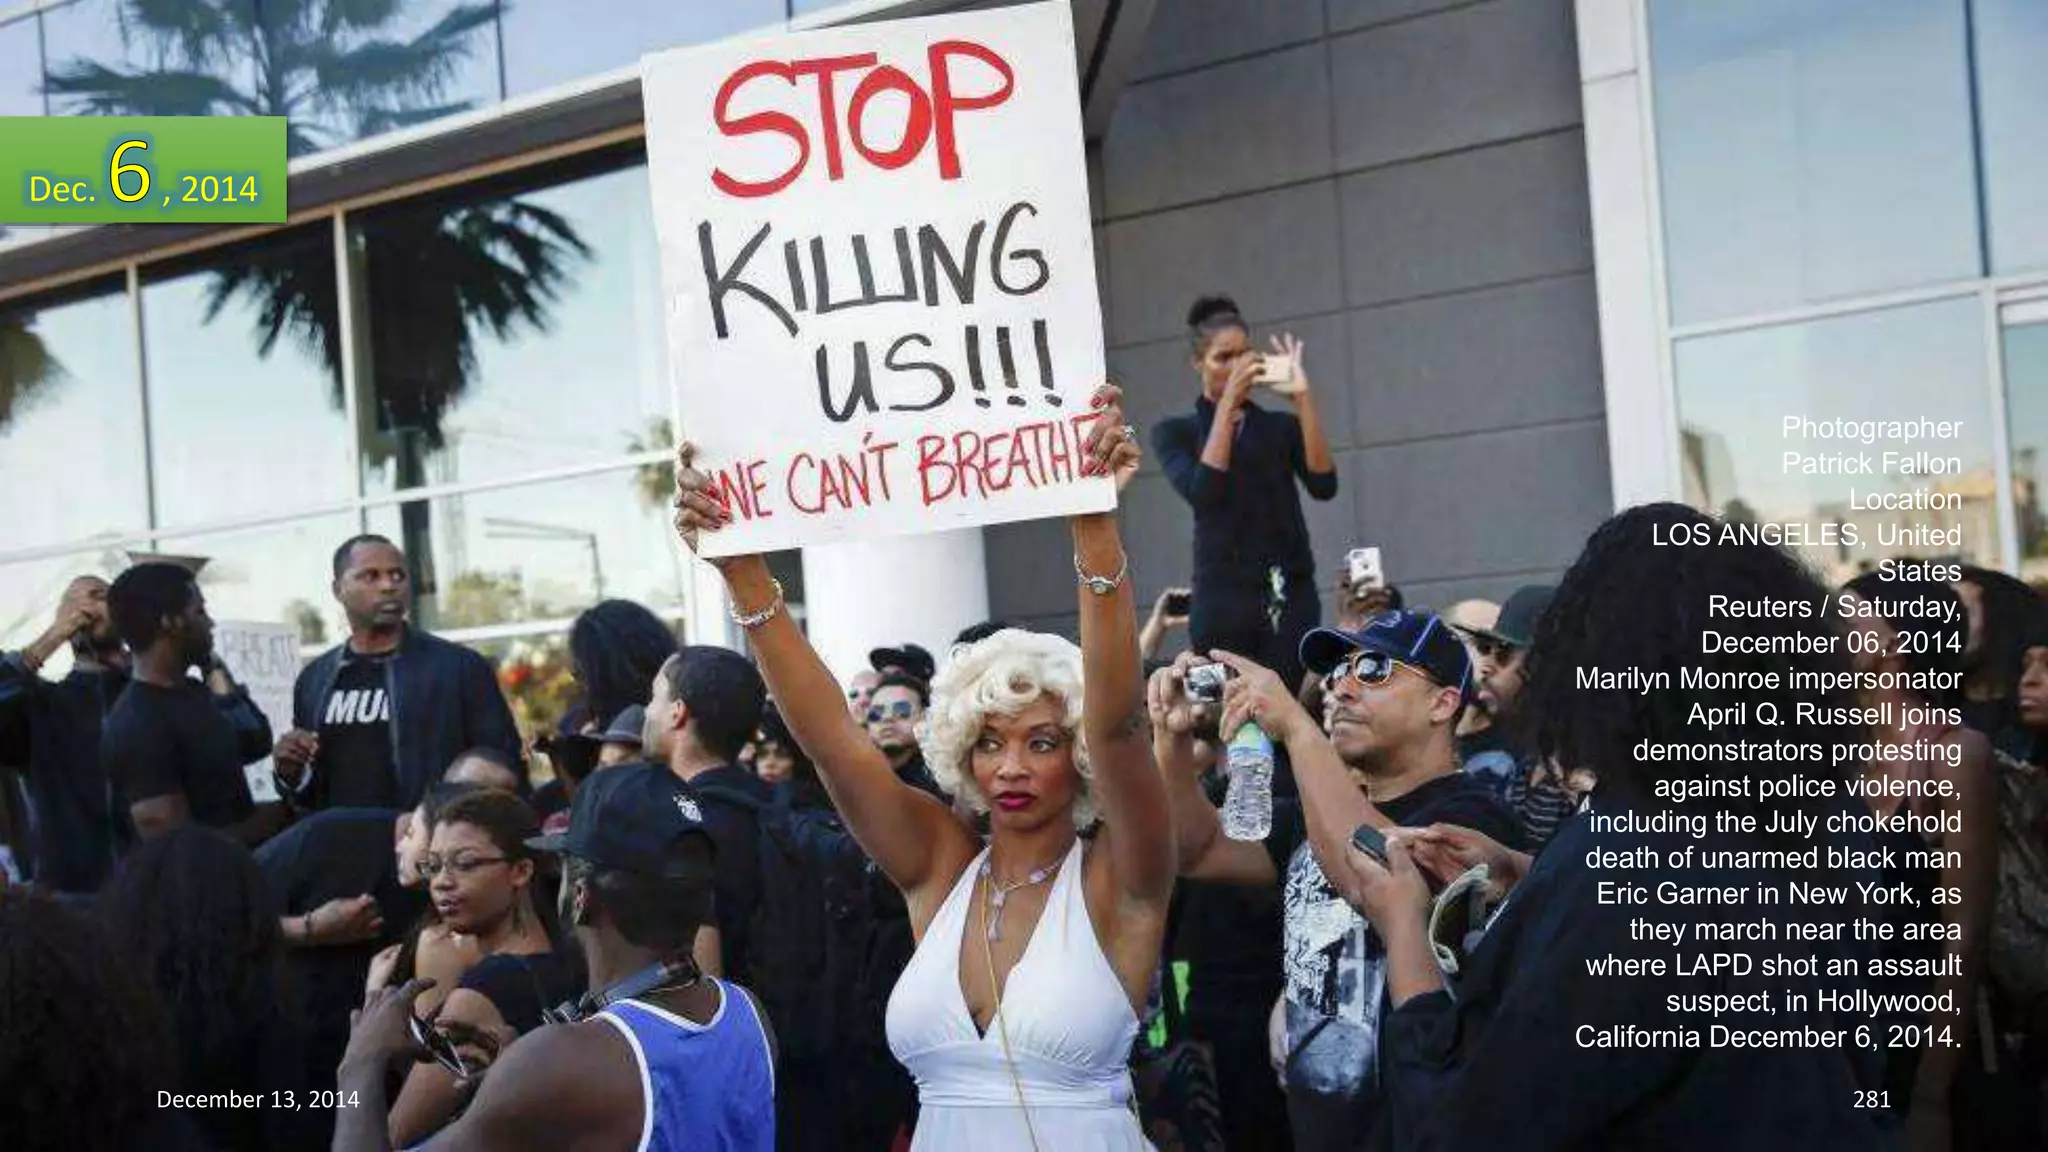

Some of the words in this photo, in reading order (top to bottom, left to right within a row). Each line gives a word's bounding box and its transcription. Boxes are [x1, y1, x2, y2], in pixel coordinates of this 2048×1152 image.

[710, 39, 1015, 198] STOP
[697, 201, 1050, 339] KILLING
[815, 318, 1063, 423] US!!!
[706, 459, 772, 521] WE
[786, 431, 899, 514] CAN'T
